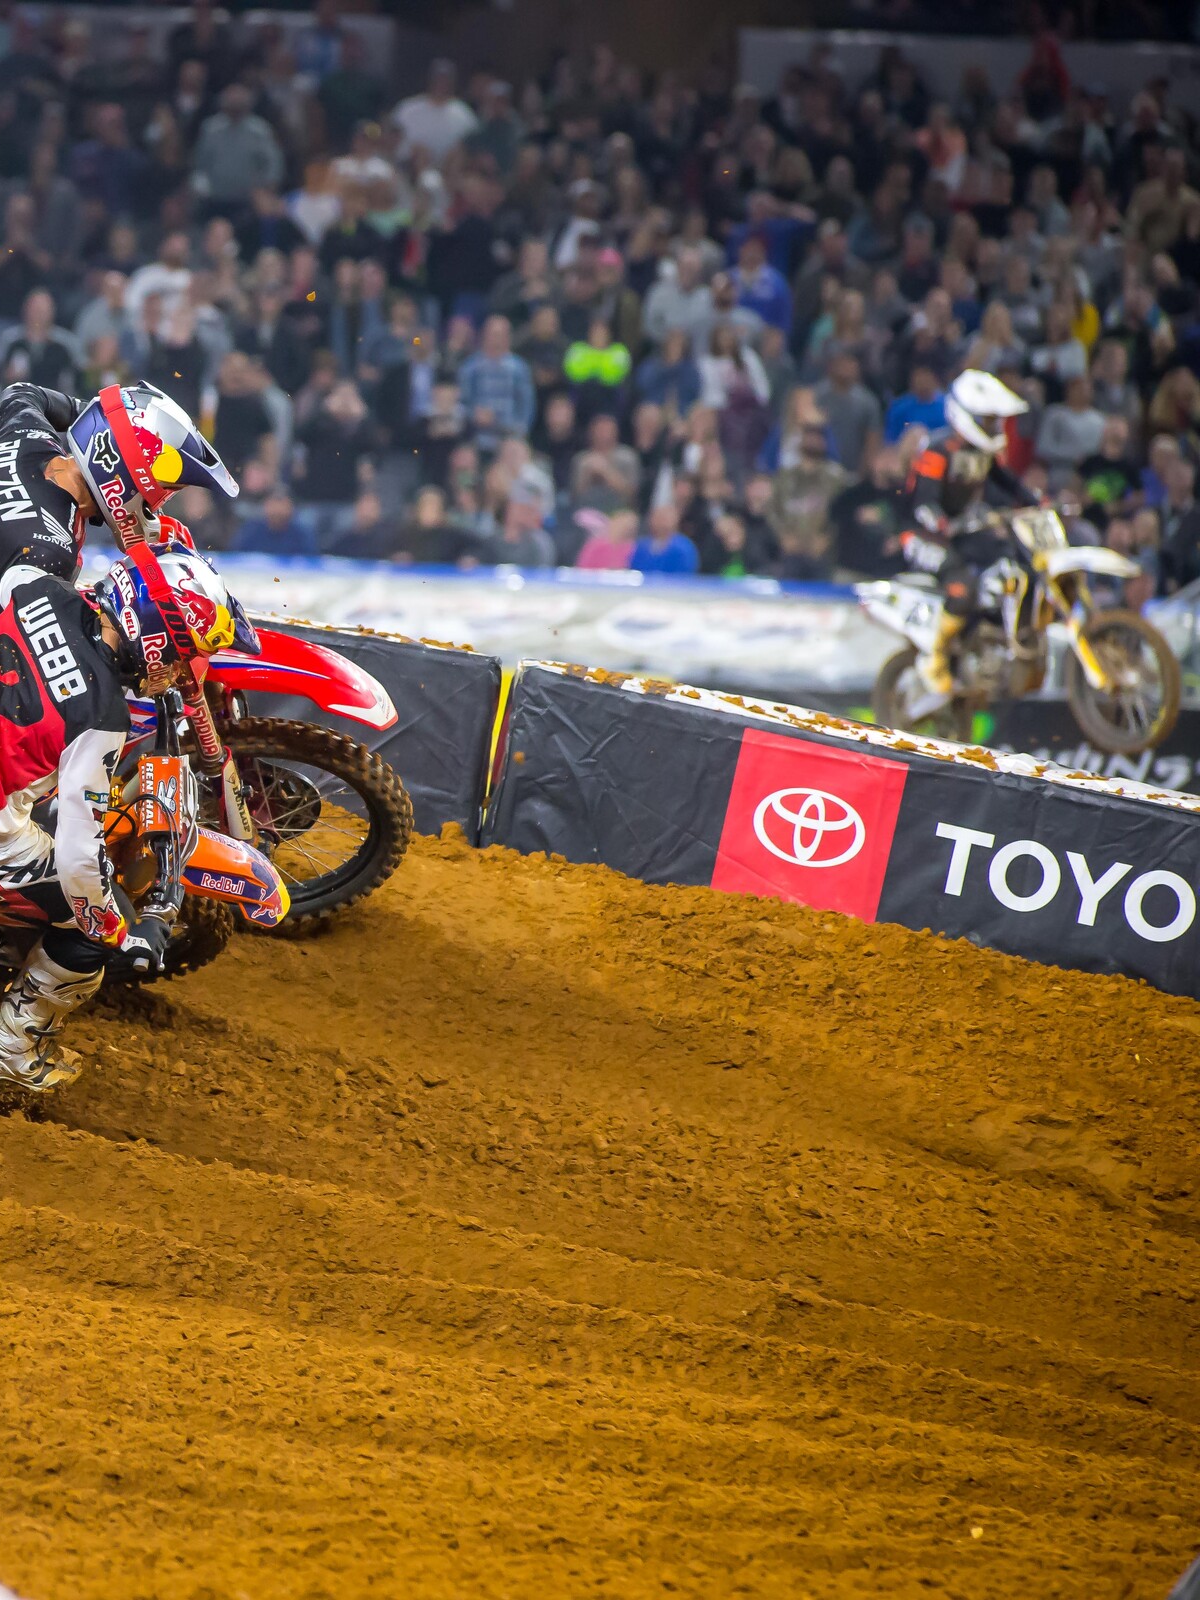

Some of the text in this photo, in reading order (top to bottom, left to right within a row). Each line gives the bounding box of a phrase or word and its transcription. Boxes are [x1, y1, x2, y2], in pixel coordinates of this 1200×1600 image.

[135, 468, 155, 491] FOX
[33, 533, 73, 553] HONDA
[124, 611, 137, 639] BELL
[17, 596, 88, 703] WEBB
[935, 822, 1197, 942] TOYO
